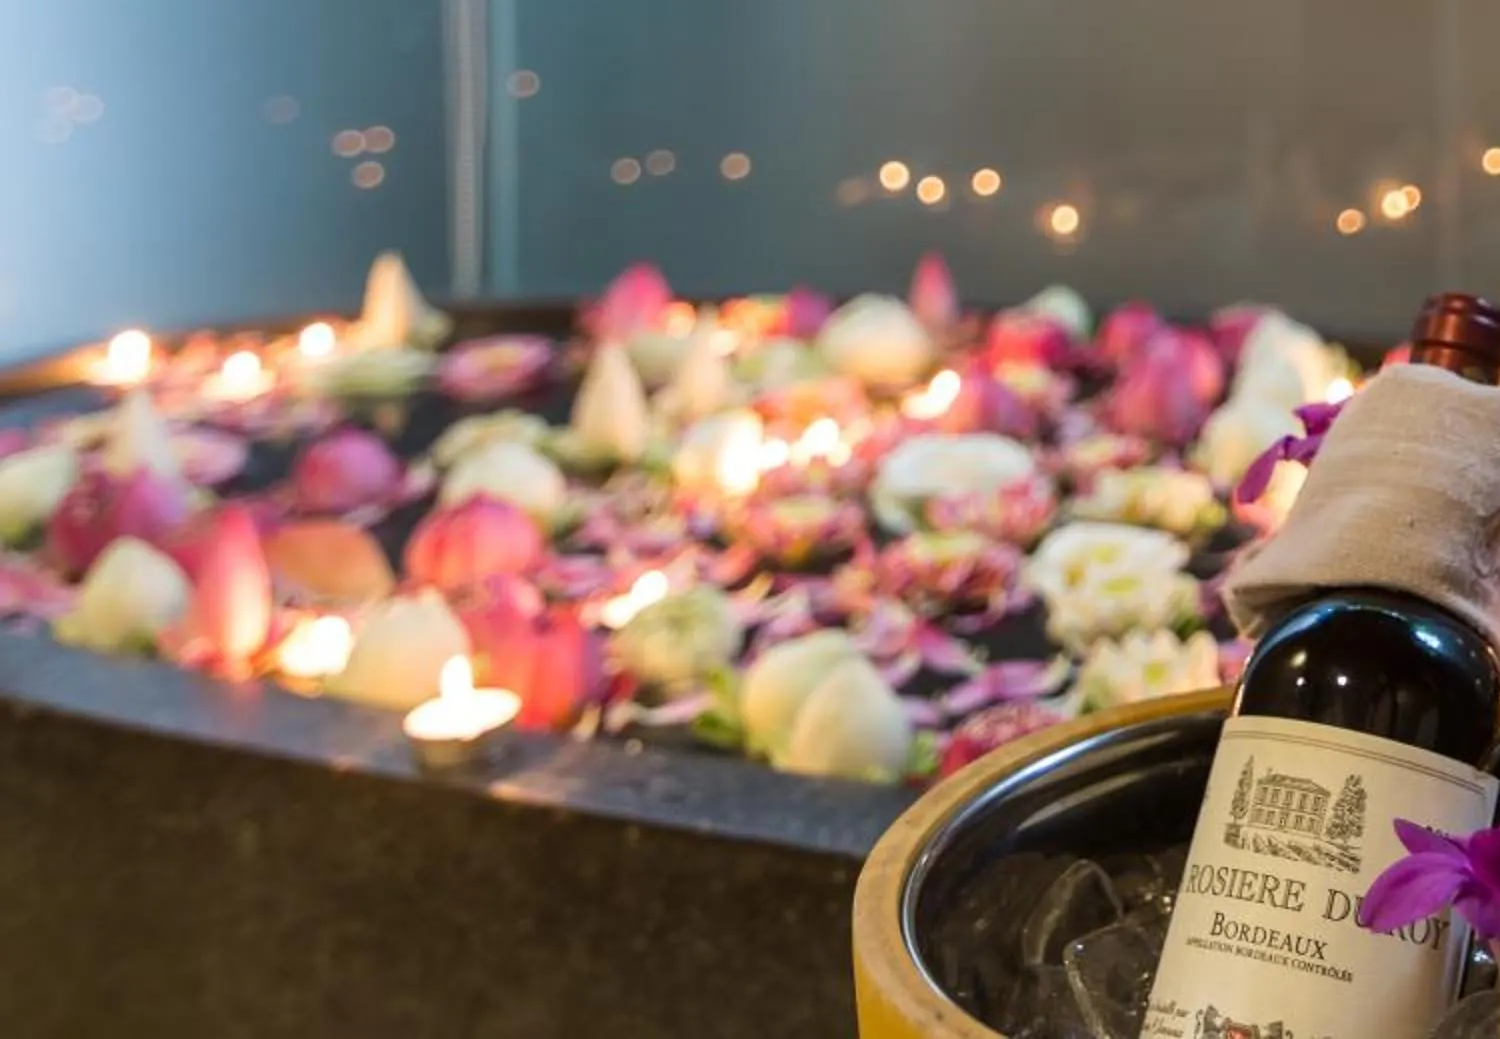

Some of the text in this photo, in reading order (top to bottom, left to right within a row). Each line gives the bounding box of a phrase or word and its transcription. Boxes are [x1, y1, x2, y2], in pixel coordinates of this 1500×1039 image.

[1185, 864, 1306, 912] ROSIERE
[1210, 910, 1328, 960] BORDEAUX
[1234, 946, 1289, 966] BORDEAUX
